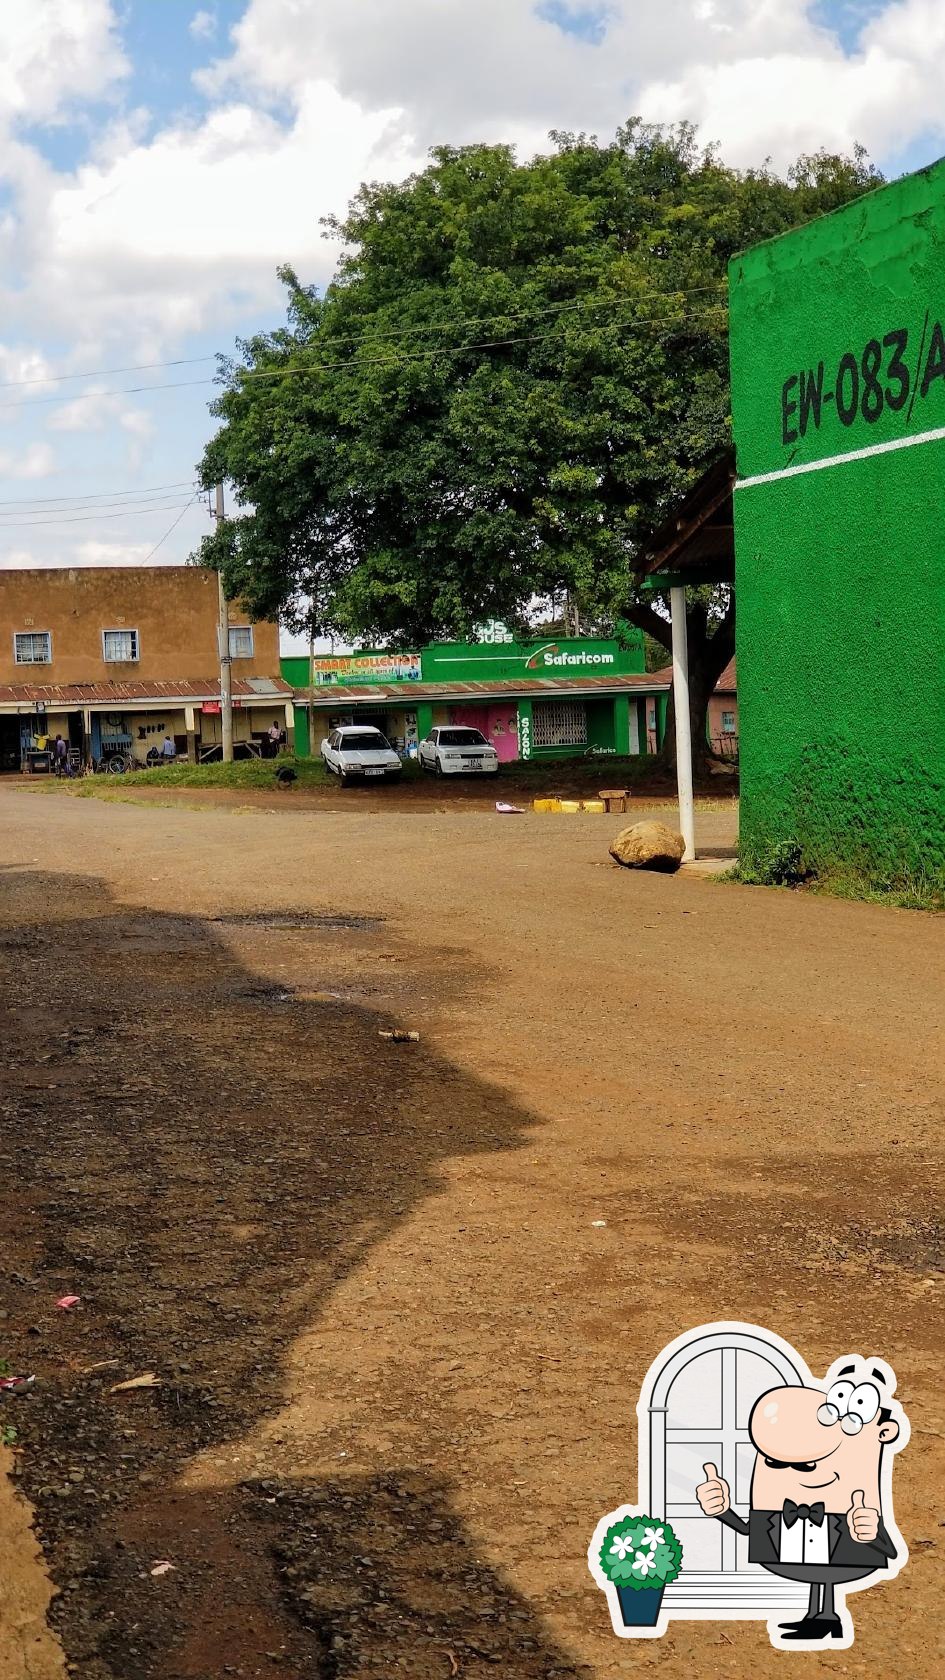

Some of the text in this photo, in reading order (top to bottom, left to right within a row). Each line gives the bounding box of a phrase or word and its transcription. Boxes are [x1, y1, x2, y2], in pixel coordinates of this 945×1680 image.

[782, 309, 945, 445] EW-083/A
[314, 655, 419, 671] SMART COLLECTION
[543, 651, 614, 665] Safaricom
